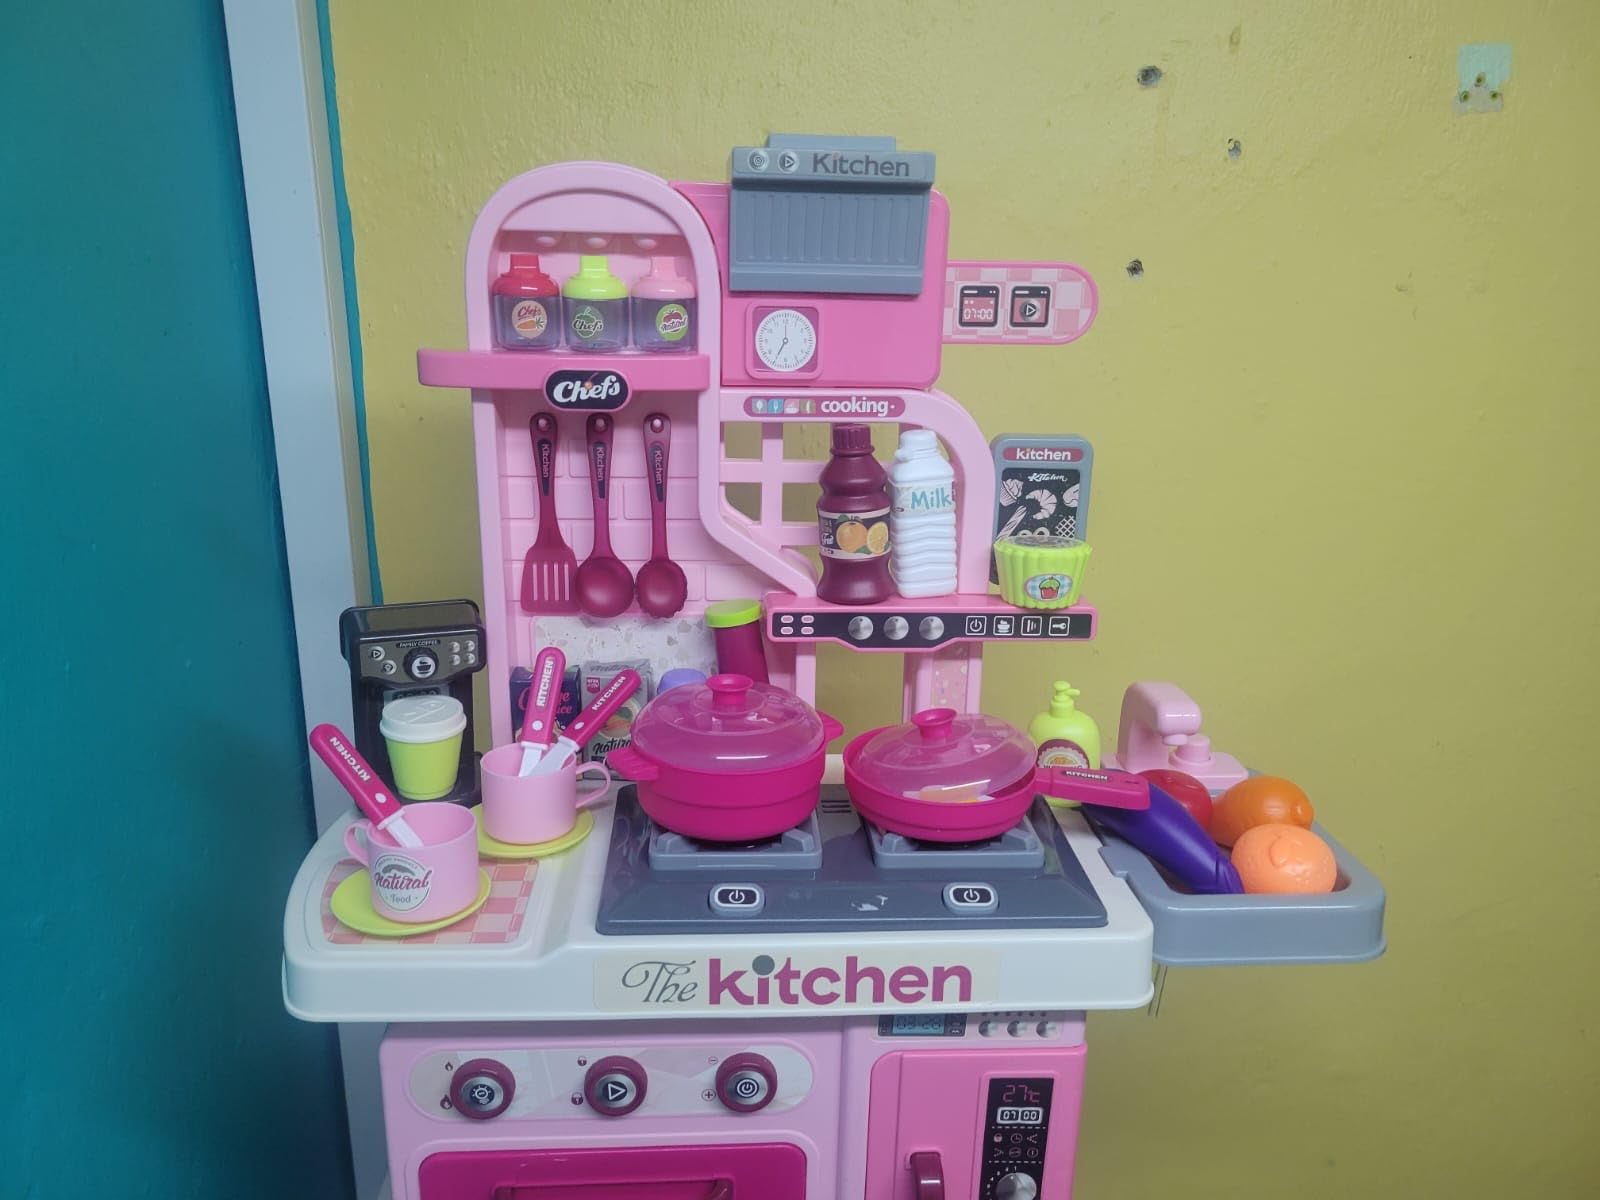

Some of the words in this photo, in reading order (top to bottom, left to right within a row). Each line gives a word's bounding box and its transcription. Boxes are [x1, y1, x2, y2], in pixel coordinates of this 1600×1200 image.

[812, 152, 910, 177] Kitchen
[820, 397, 889, 417] cooking
[541, 443, 549, 478] Kitchen
[654, 450, 662, 485] Kitchen
[1016, 447, 1071, 461] kitchen
[911, 487, 952, 510] Milk
[536, 658, 555, 707] KITCHEN
[592, 675, 626, 711] KITCHEN
[329, 736, 371, 781] KITCHEN
[1065, 769, 1108, 781] KITCHEN
[622, 960, 699, 1003] The
[708, 954, 973, 1005] kitchen
